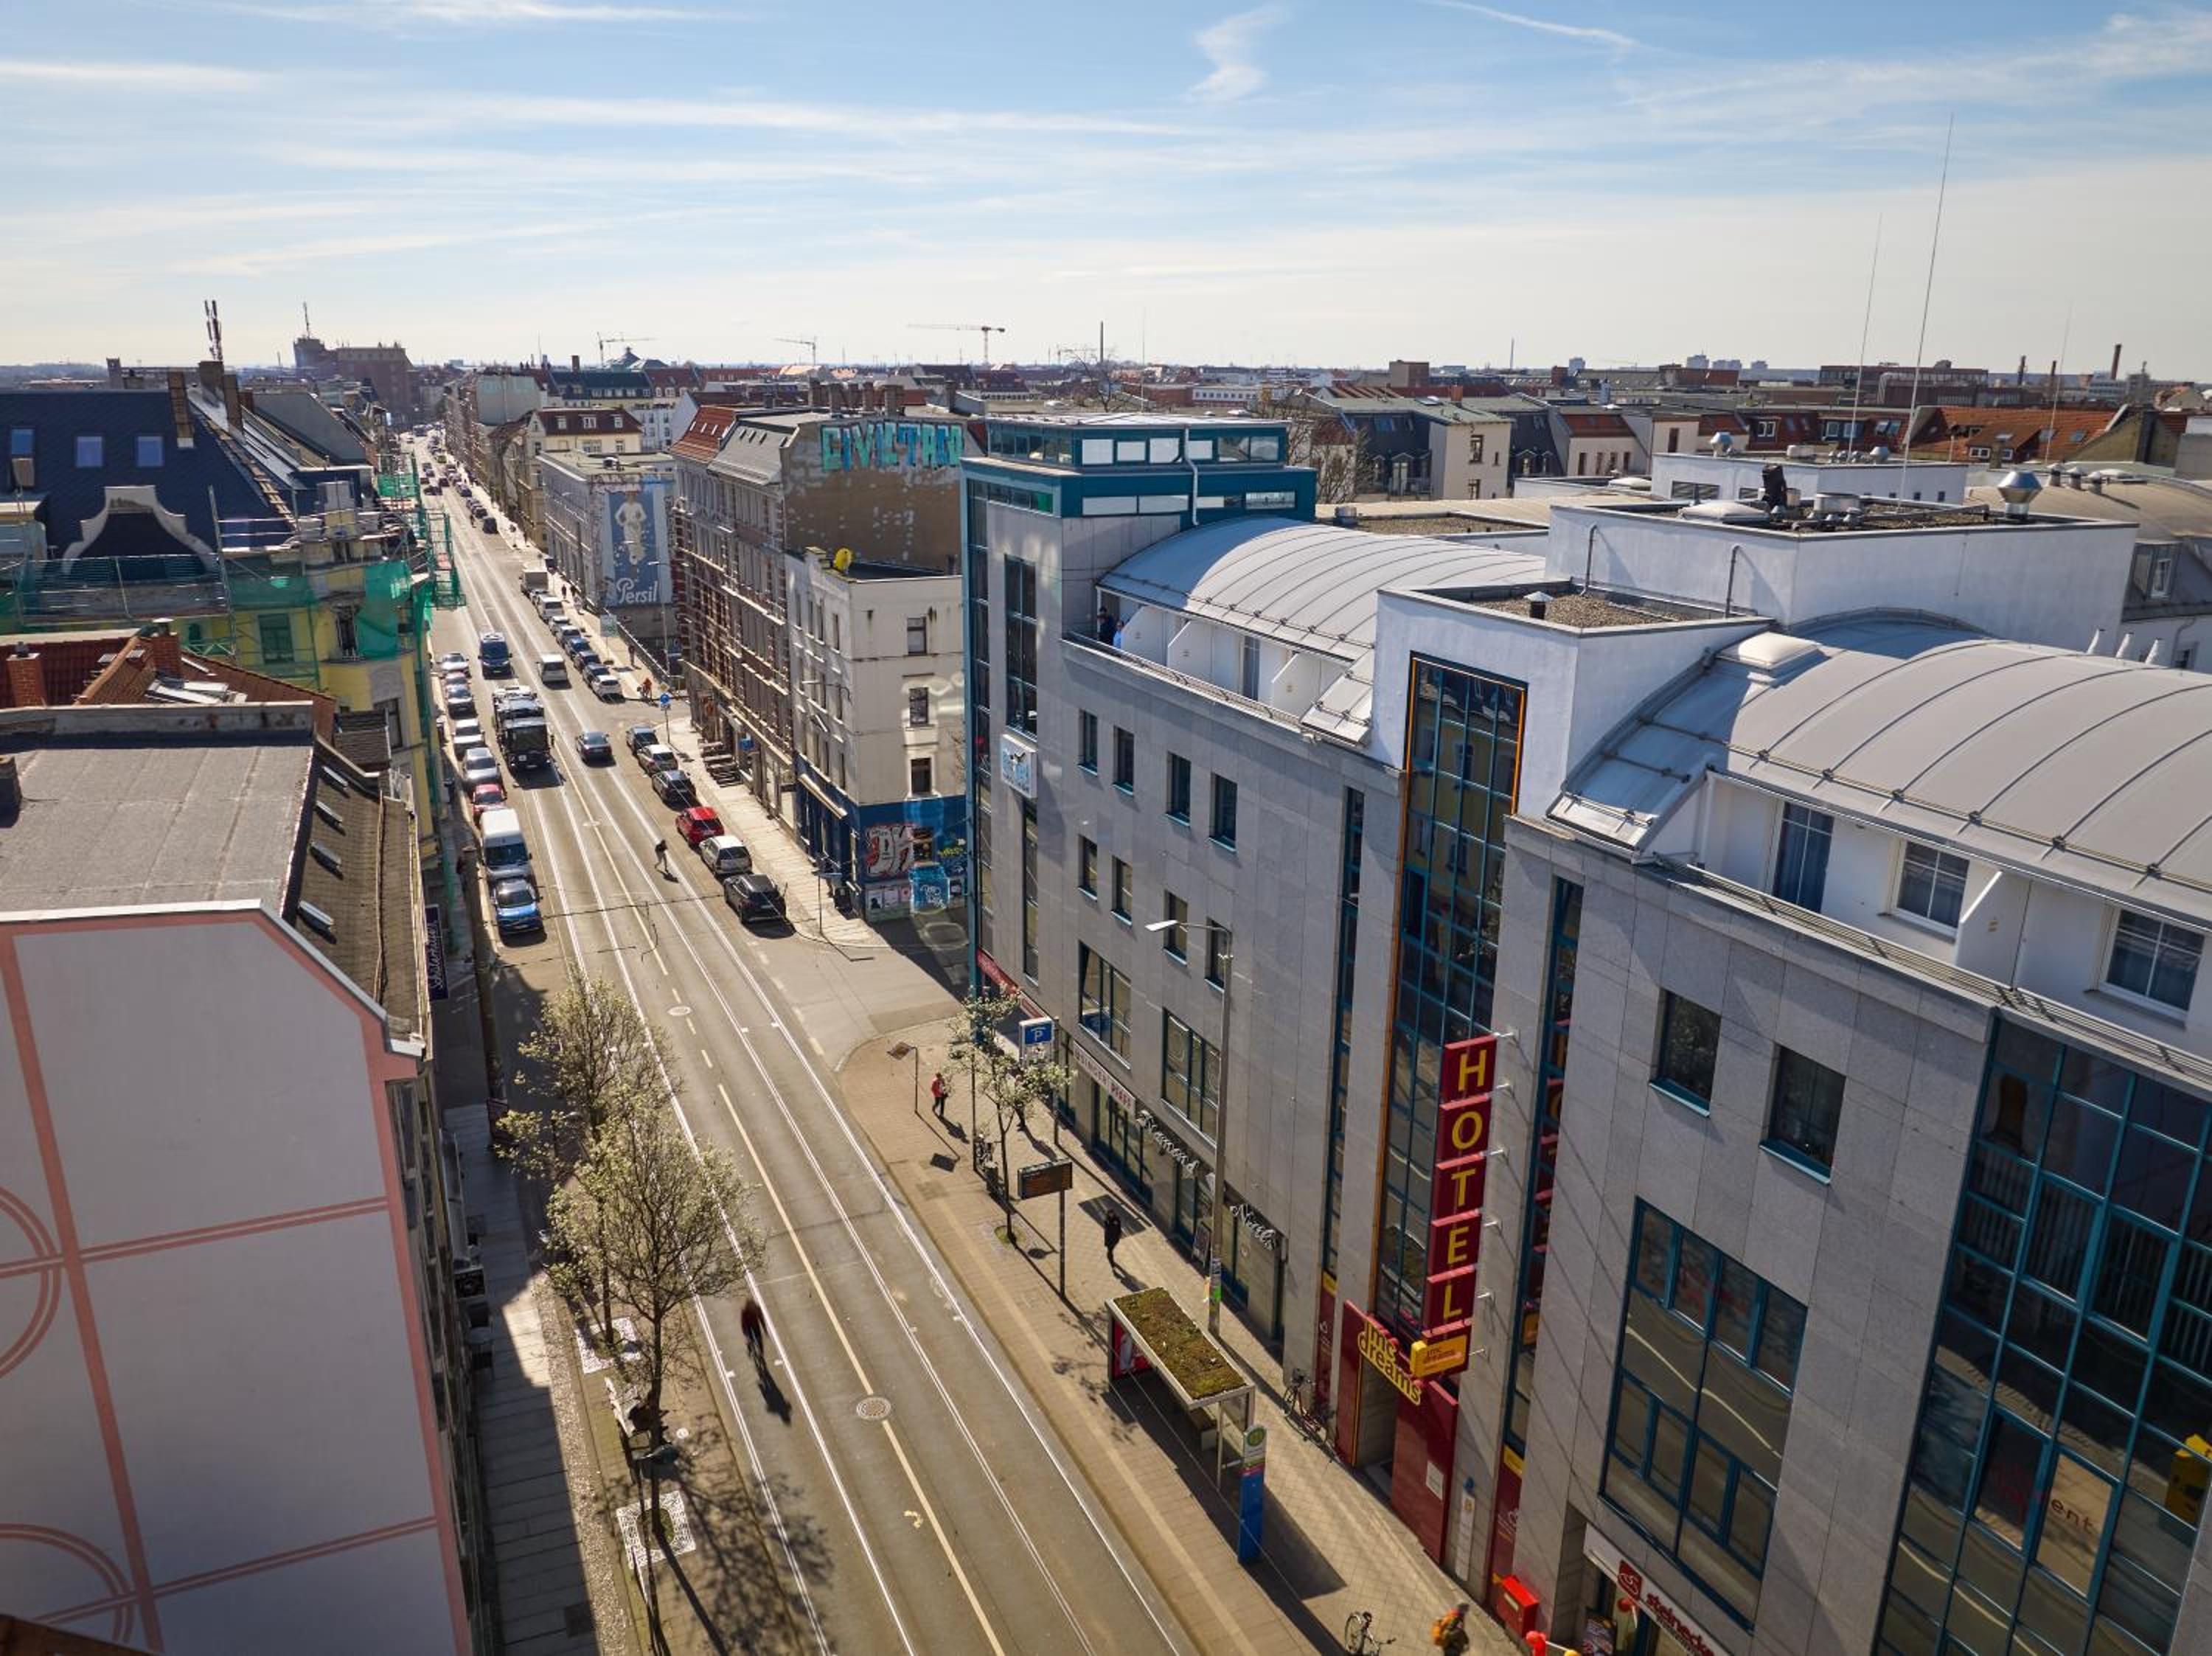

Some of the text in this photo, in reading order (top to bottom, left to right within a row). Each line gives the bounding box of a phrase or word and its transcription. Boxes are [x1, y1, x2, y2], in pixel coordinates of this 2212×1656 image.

[616, 577, 658, 603] Persil
[1443, 1048, 1487, 1320] HOTEL
[1358, 1320, 1422, 1402] dreams
